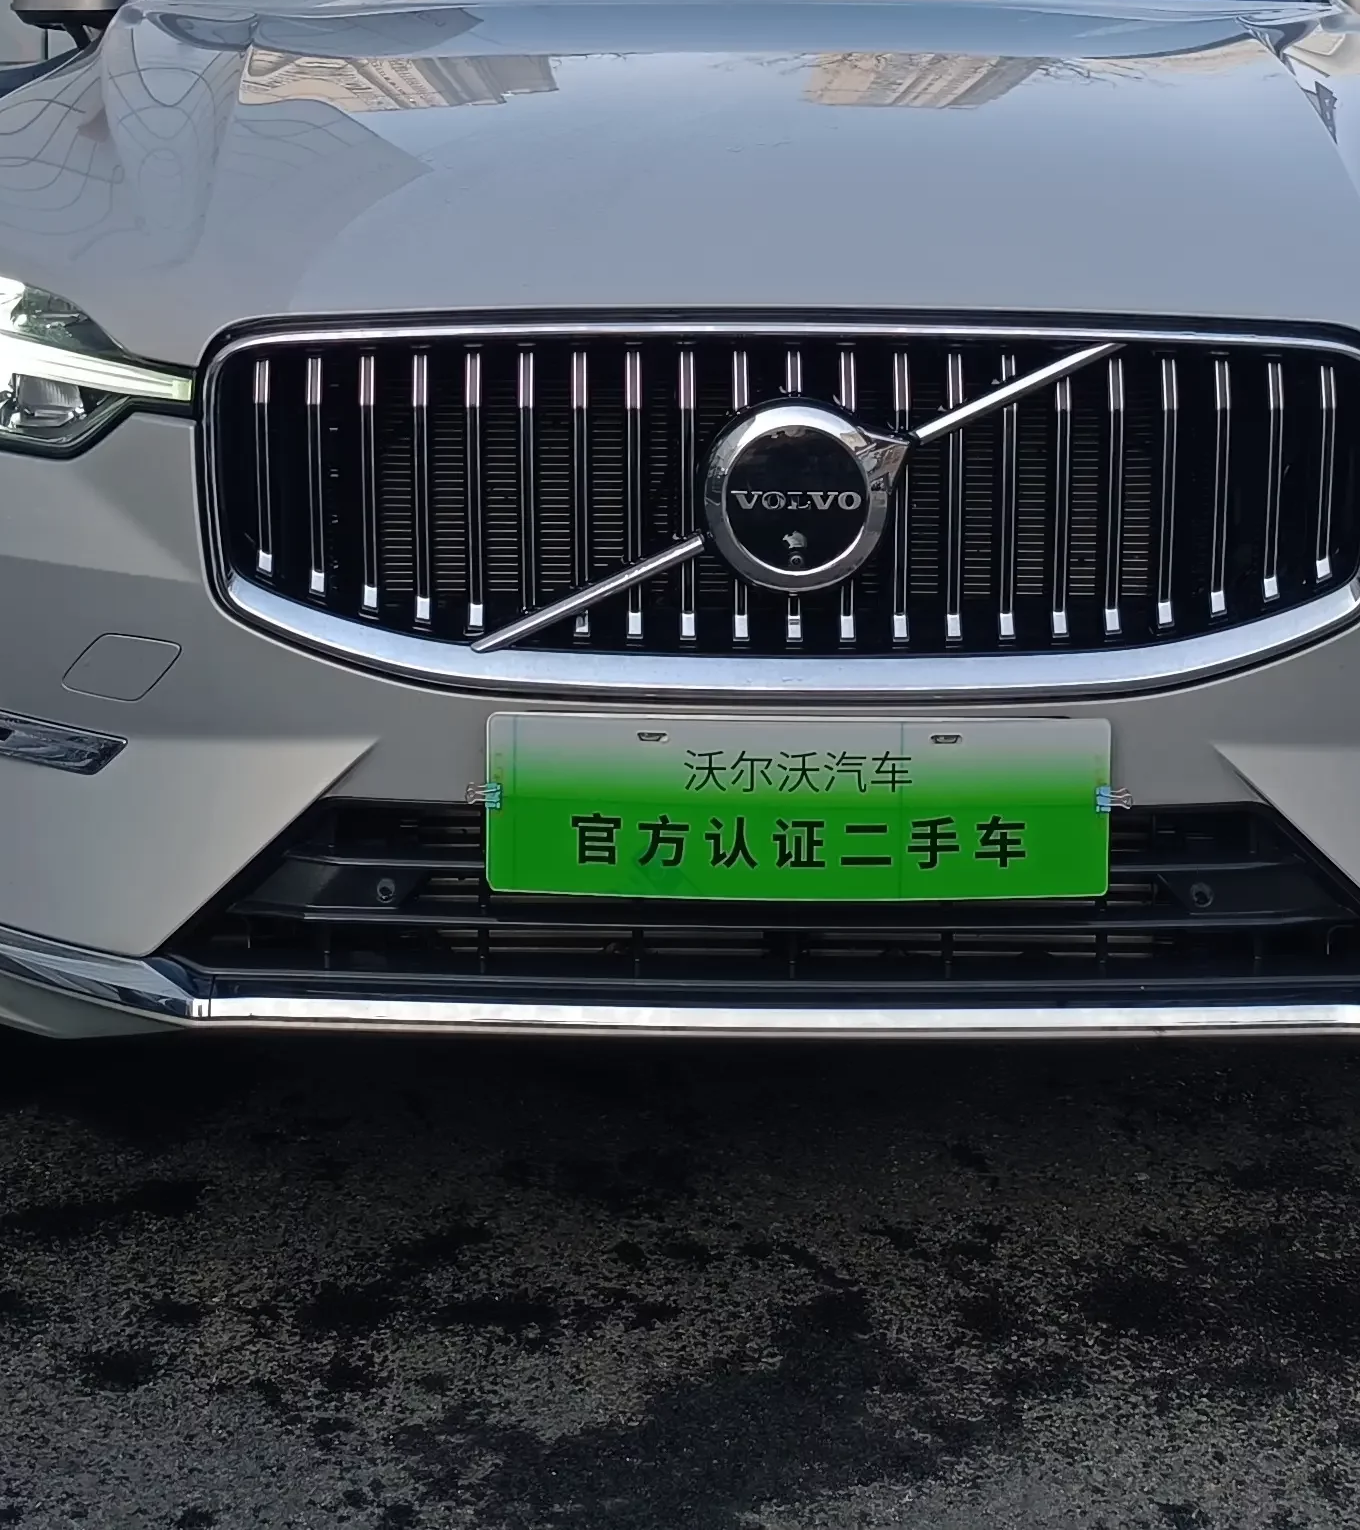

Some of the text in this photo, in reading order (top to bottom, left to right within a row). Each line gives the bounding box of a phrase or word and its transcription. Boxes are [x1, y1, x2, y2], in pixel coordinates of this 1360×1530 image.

[730, 490, 862, 511] VOLVO
[682, 748, 914, 794] 沃尔沃汽车
[570, 814, 1028, 871] 官方认证二手车
